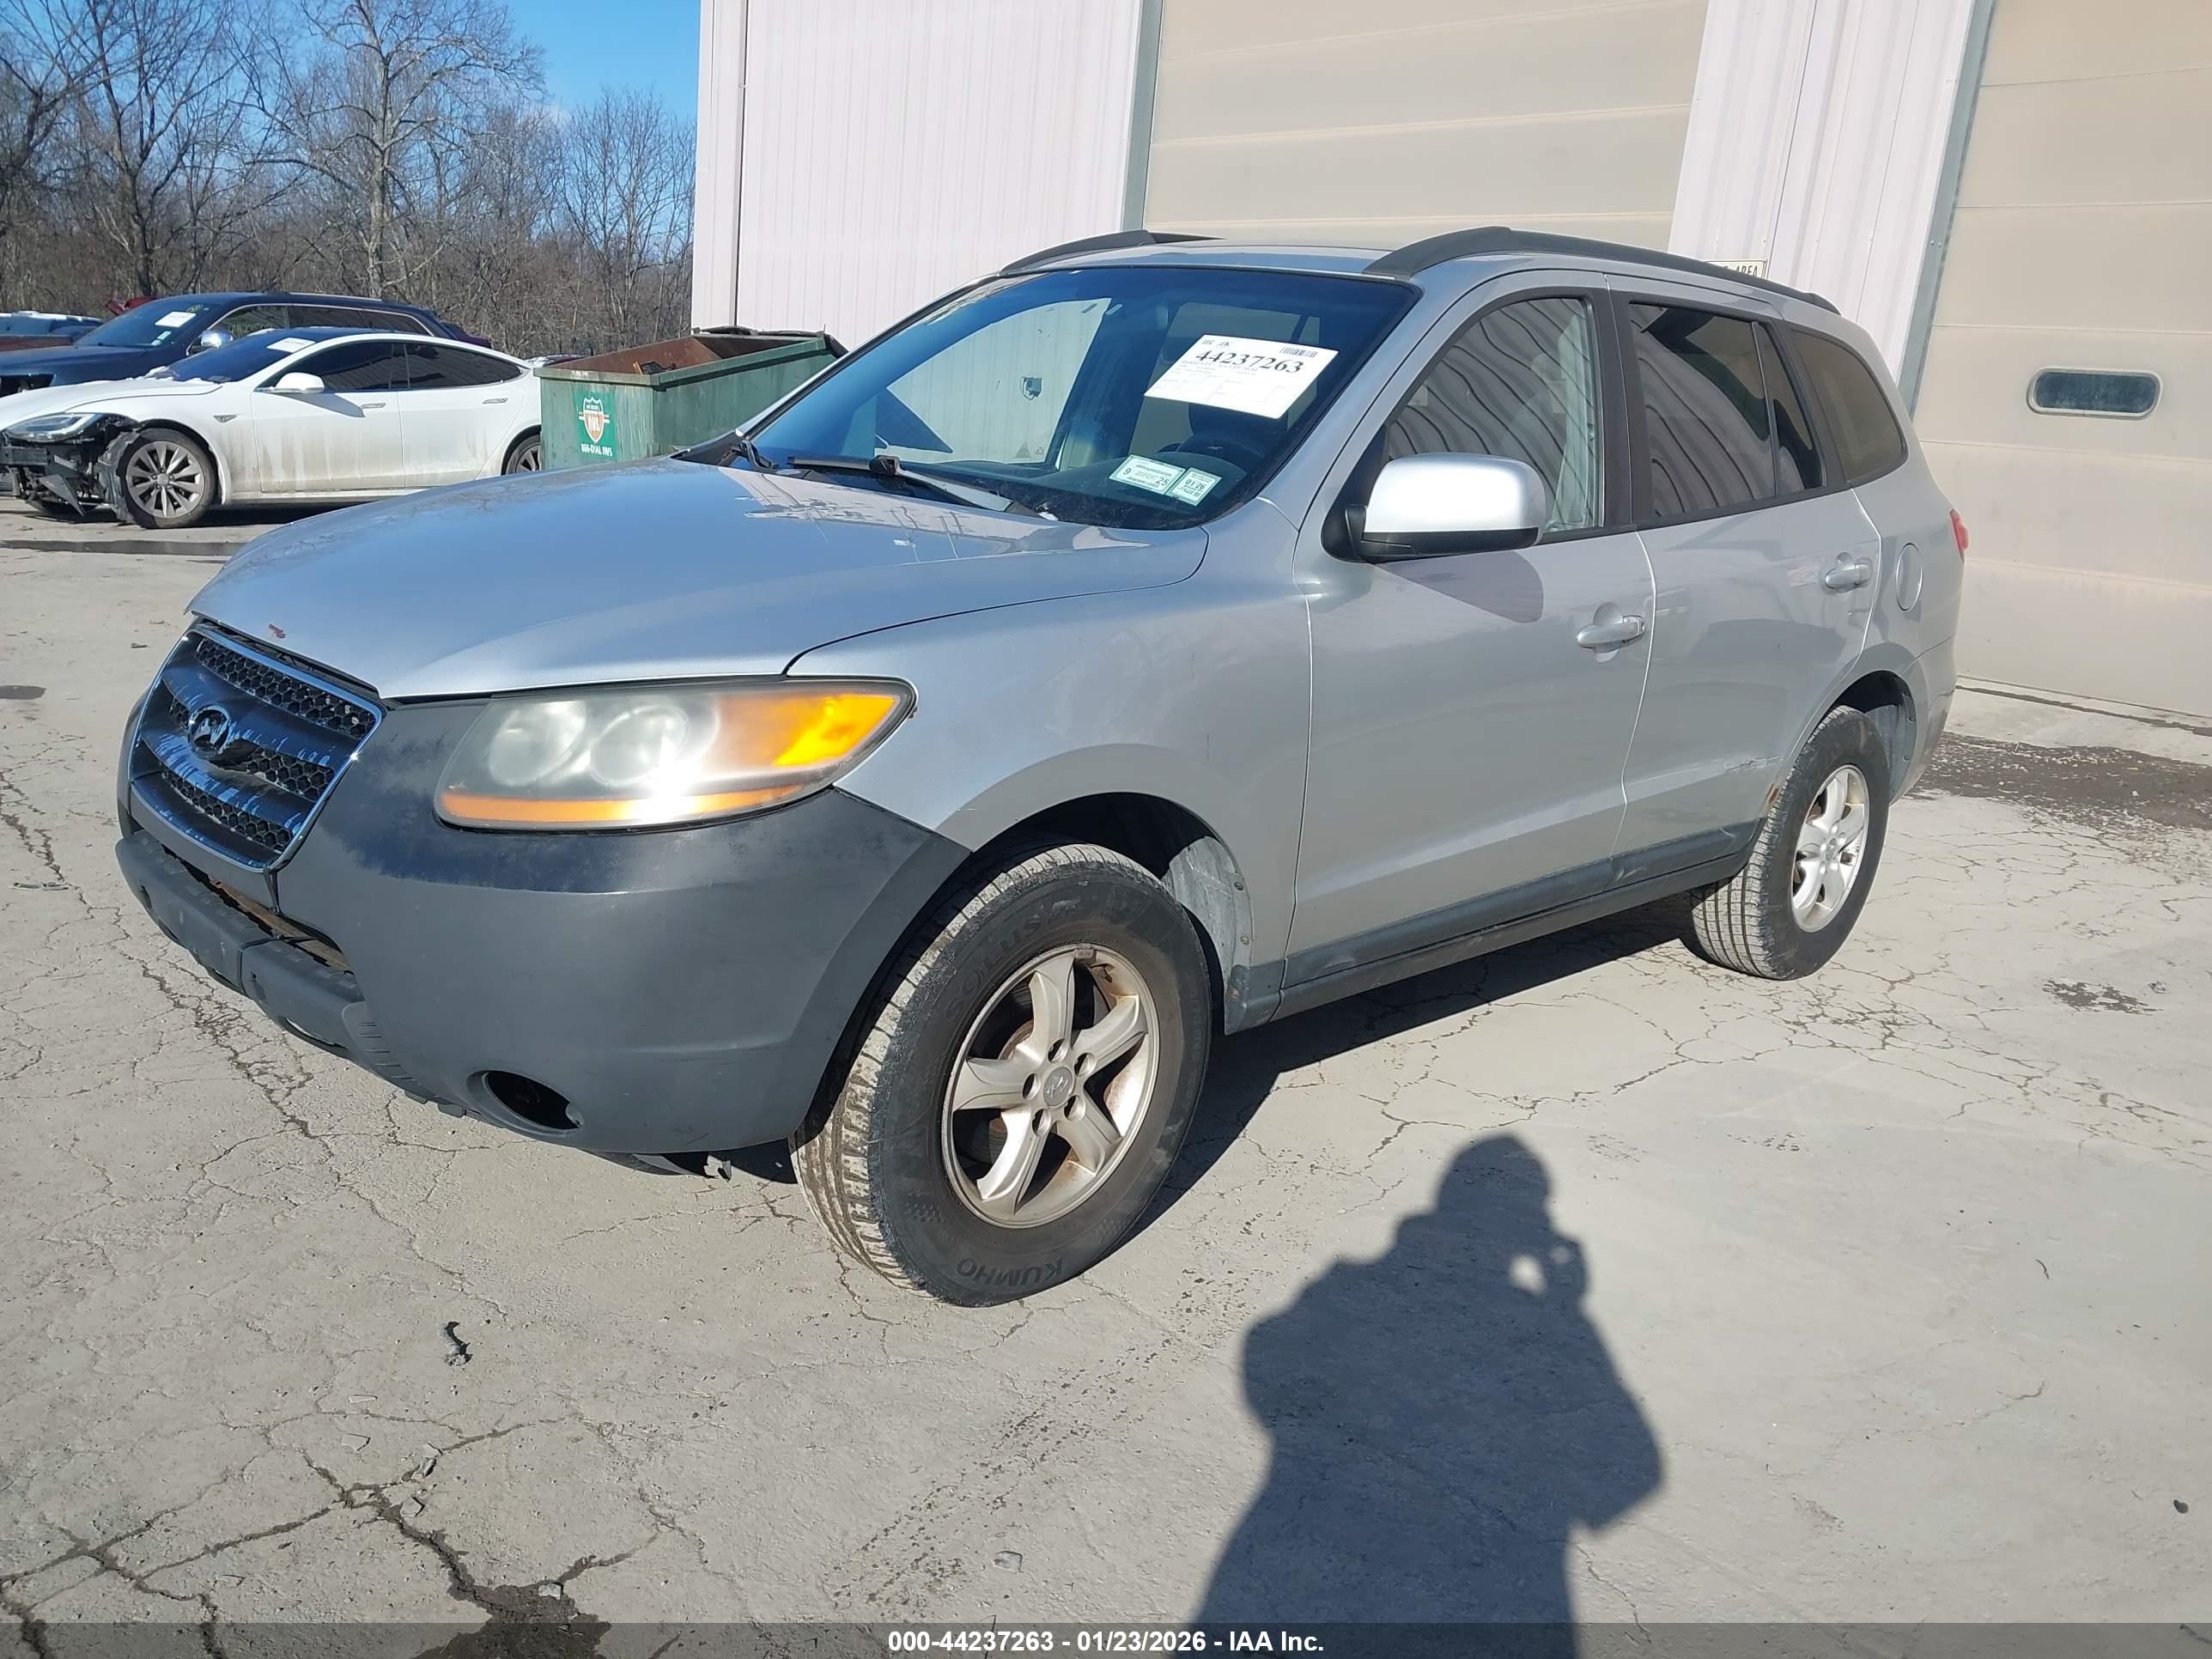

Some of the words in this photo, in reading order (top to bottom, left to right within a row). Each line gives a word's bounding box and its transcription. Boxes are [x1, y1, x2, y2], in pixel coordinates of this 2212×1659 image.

[1195, 349, 1304, 374] 44237263
[1156, 477, 1170, 487] 25
[957, 1257, 1063, 1286] KUMHO
